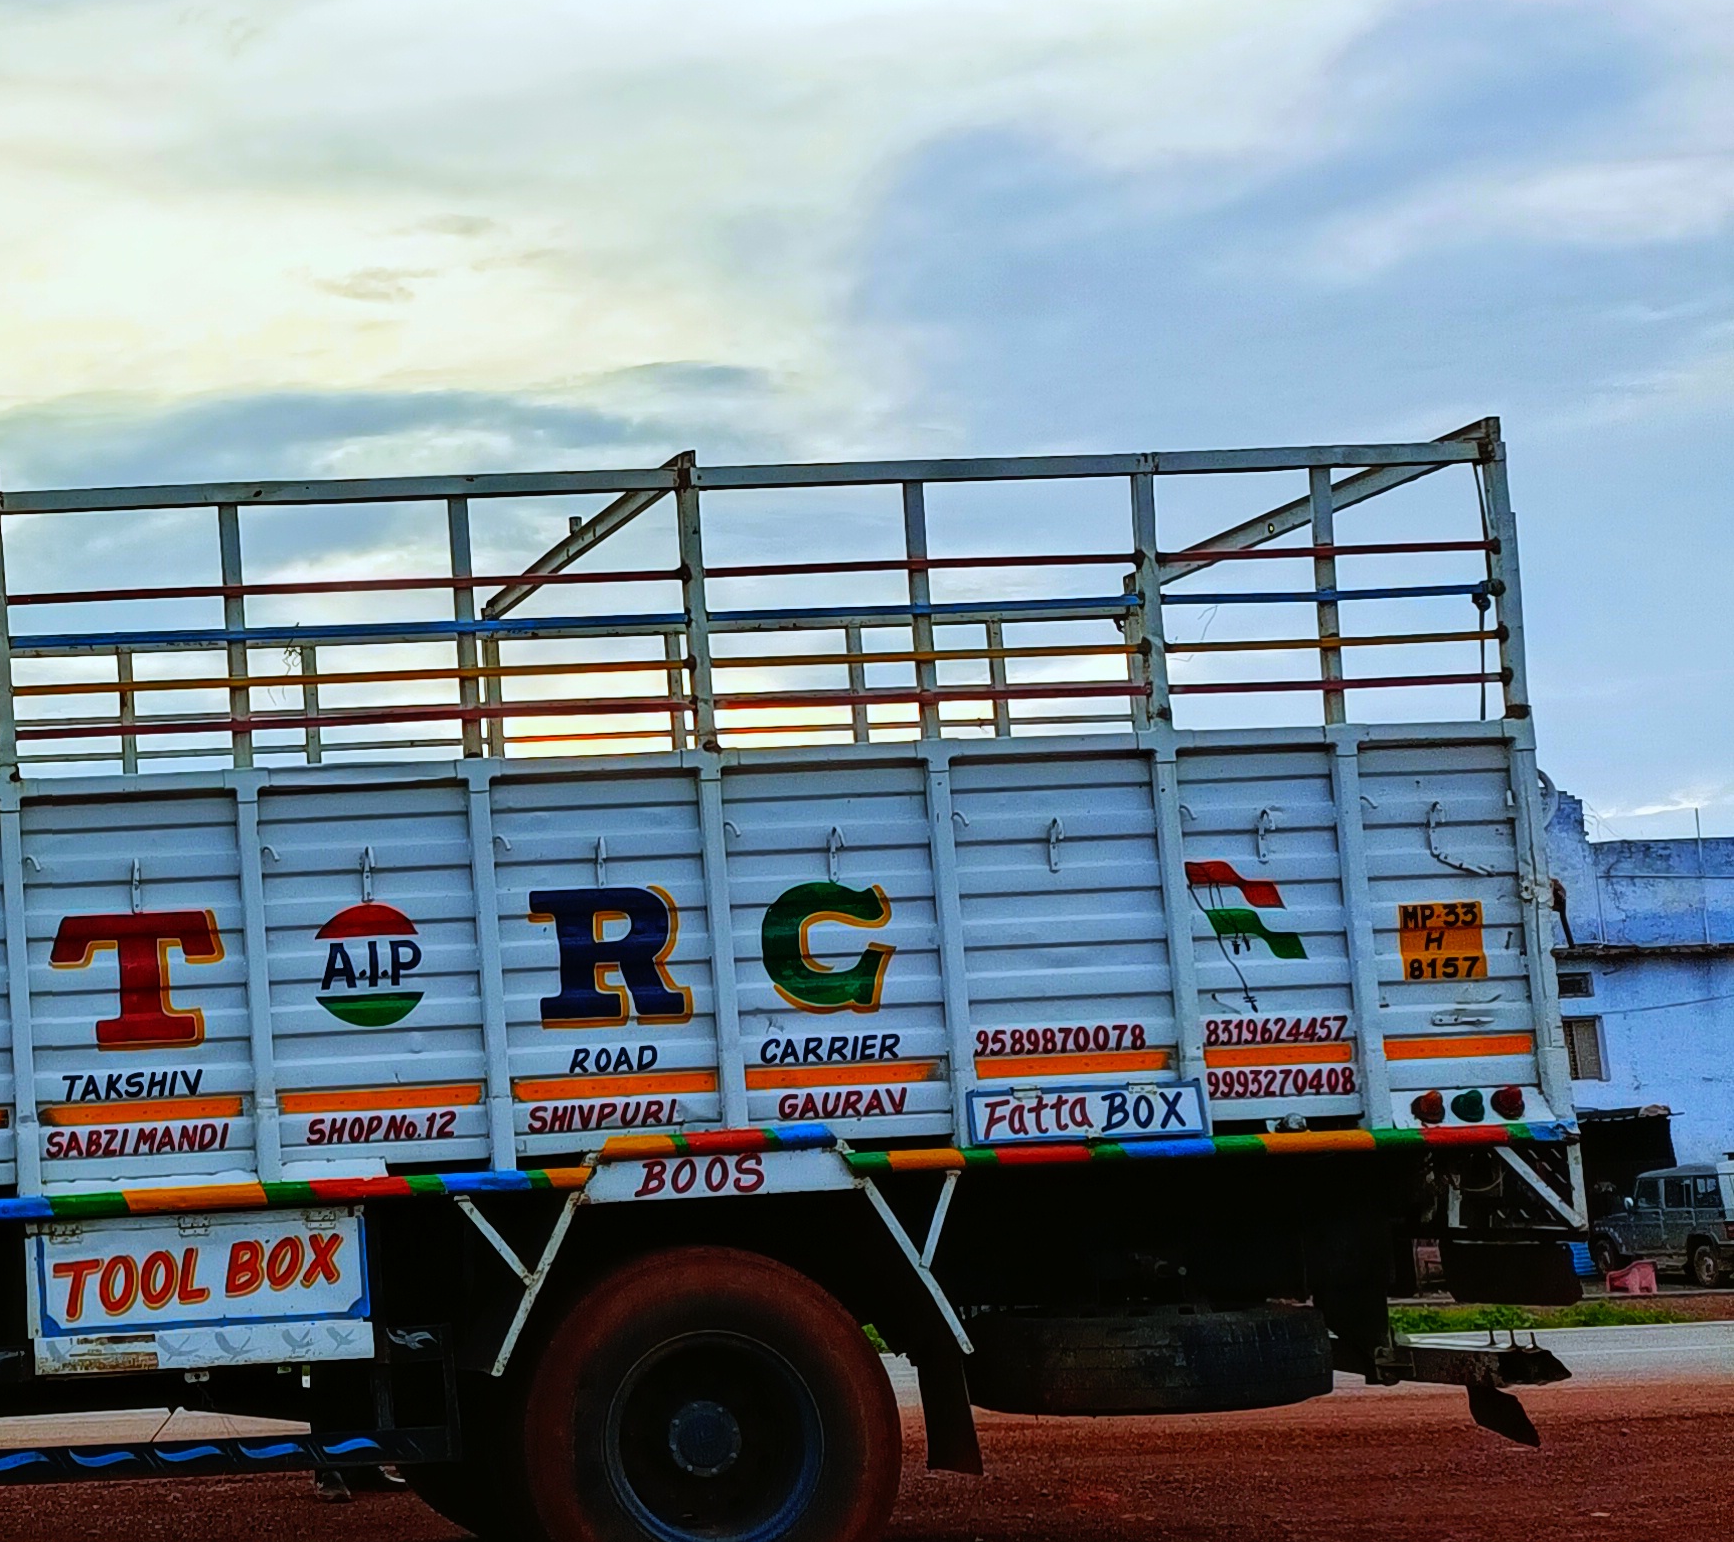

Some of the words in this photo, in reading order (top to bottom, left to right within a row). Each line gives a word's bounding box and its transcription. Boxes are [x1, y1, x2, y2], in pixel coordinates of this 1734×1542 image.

[1424, 930, 1445, 951] H
[48, 908, 224, 1051] T
[527, 885, 694, 1029] R
[1409, 955, 1480, 980] 8157
[974, 1023, 1146, 1057] 9589870078
[1206, 1015, 1348, 1046] 8319624457
[62, 1069, 203, 1102] TAKSHIV
[569, 1044, 658, 1074] ROAD
[761, 1033, 900, 1065] CARRIER
[1207, 1067, 1356, 1098] 9993270408
[778, 1087, 907, 1120] GAURAV
[982, 1096, 1092, 1140] Fatta
[1101, 1090, 1186, 1132] BOX
[46, 1128, 129, 1158] SABZI
[132, 1122, 229, 1155] MANDI
[307, 1115, 383, 1145] SHOP
[426, 1110, 456, 1139] 12
[528, 1098, 677, 1134] SHIVPURI
[634, 1153, 765, 1197] BOOS
[53, 1247, 211, 1322] TOOL
[225, 1232, 343, 1298] BOX
